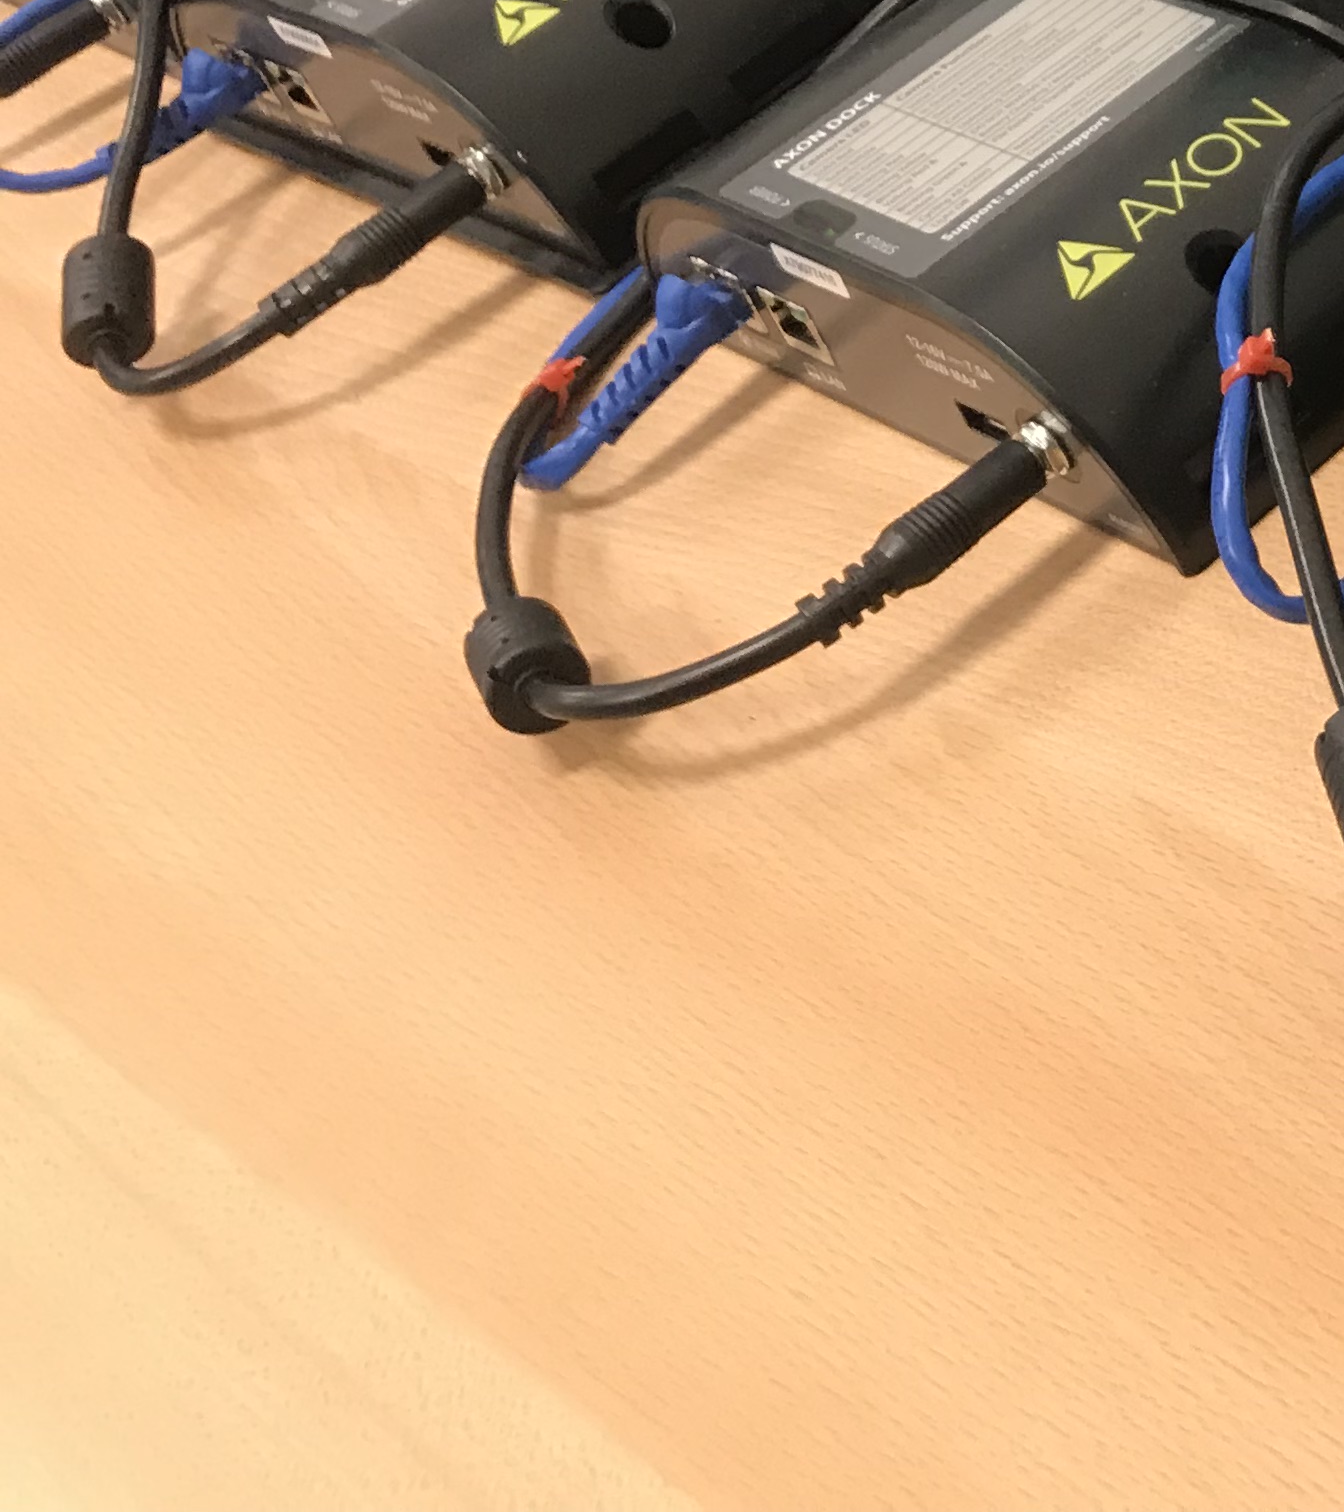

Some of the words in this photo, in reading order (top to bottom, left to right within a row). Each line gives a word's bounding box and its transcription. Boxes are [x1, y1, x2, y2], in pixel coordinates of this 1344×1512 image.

[773, 129, 826, 168] AXON
[825, 92, 880, 129] DOCK
[1117, 97, 1291, 242] AXON
